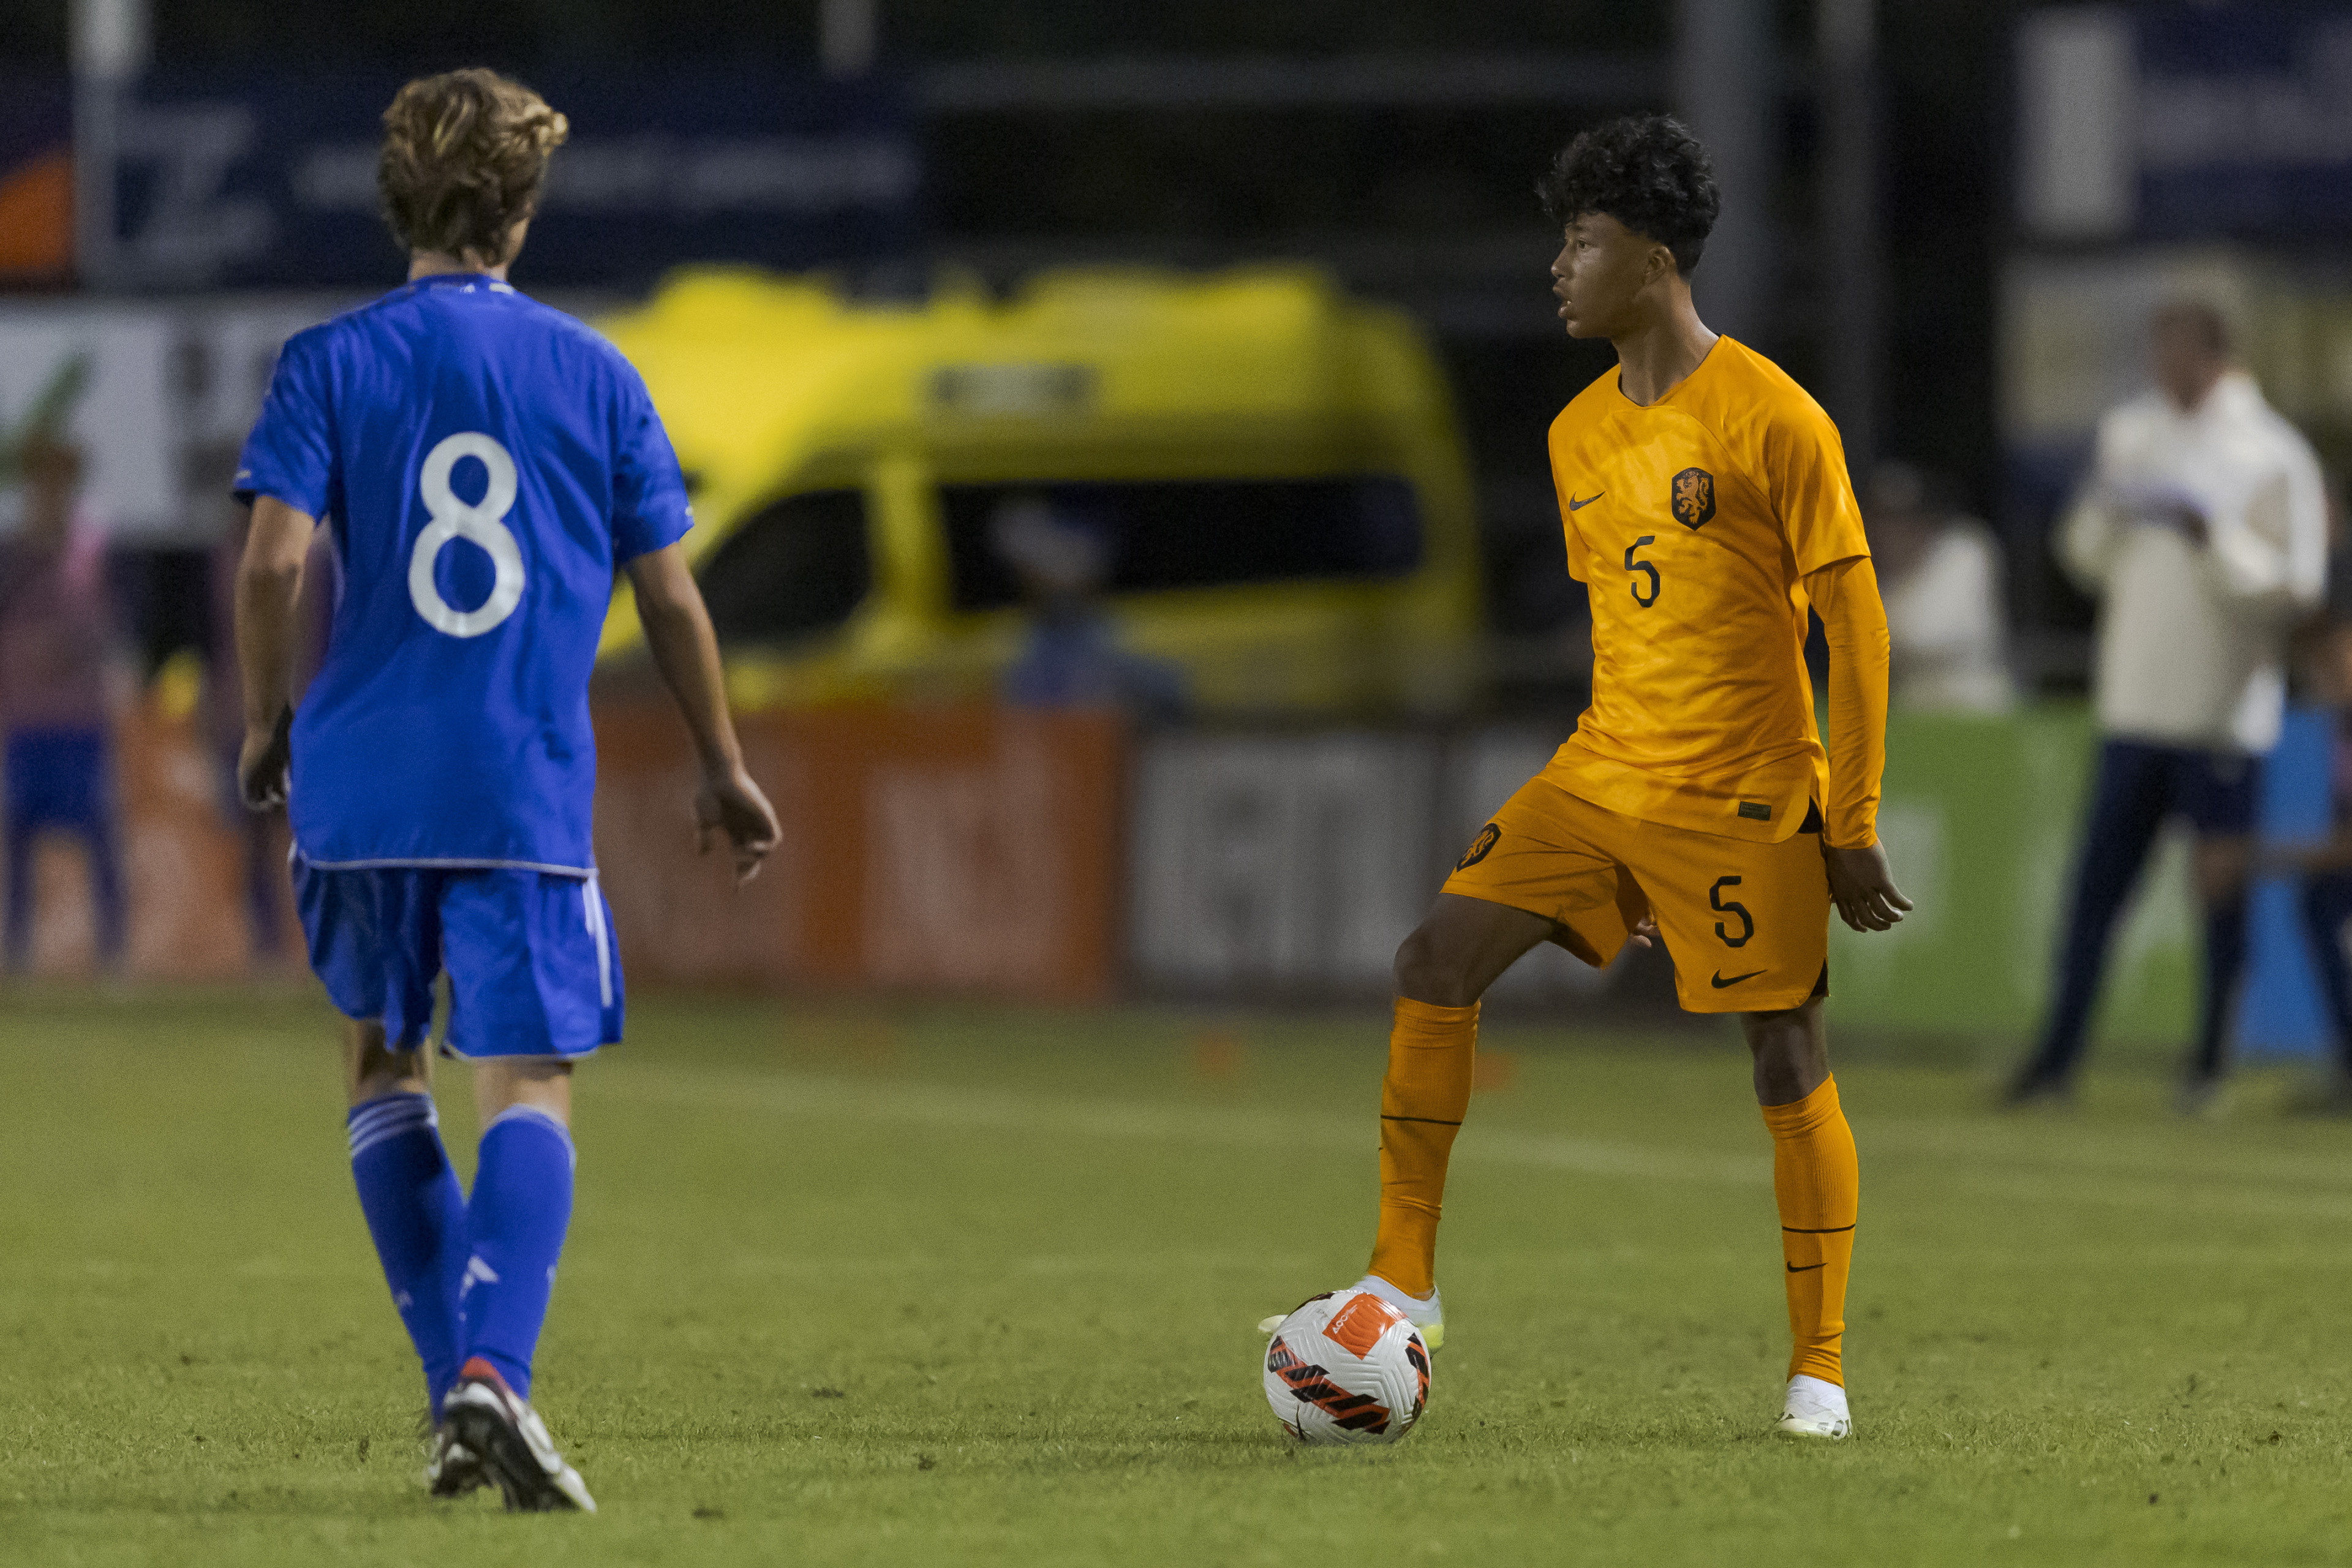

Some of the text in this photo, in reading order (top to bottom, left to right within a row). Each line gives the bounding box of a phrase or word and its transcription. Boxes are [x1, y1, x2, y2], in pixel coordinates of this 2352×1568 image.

[408, 431, 526, 638] 8
[1624, 535, 1660, 608] 5
[1709, 875, 1755, 948] 5
